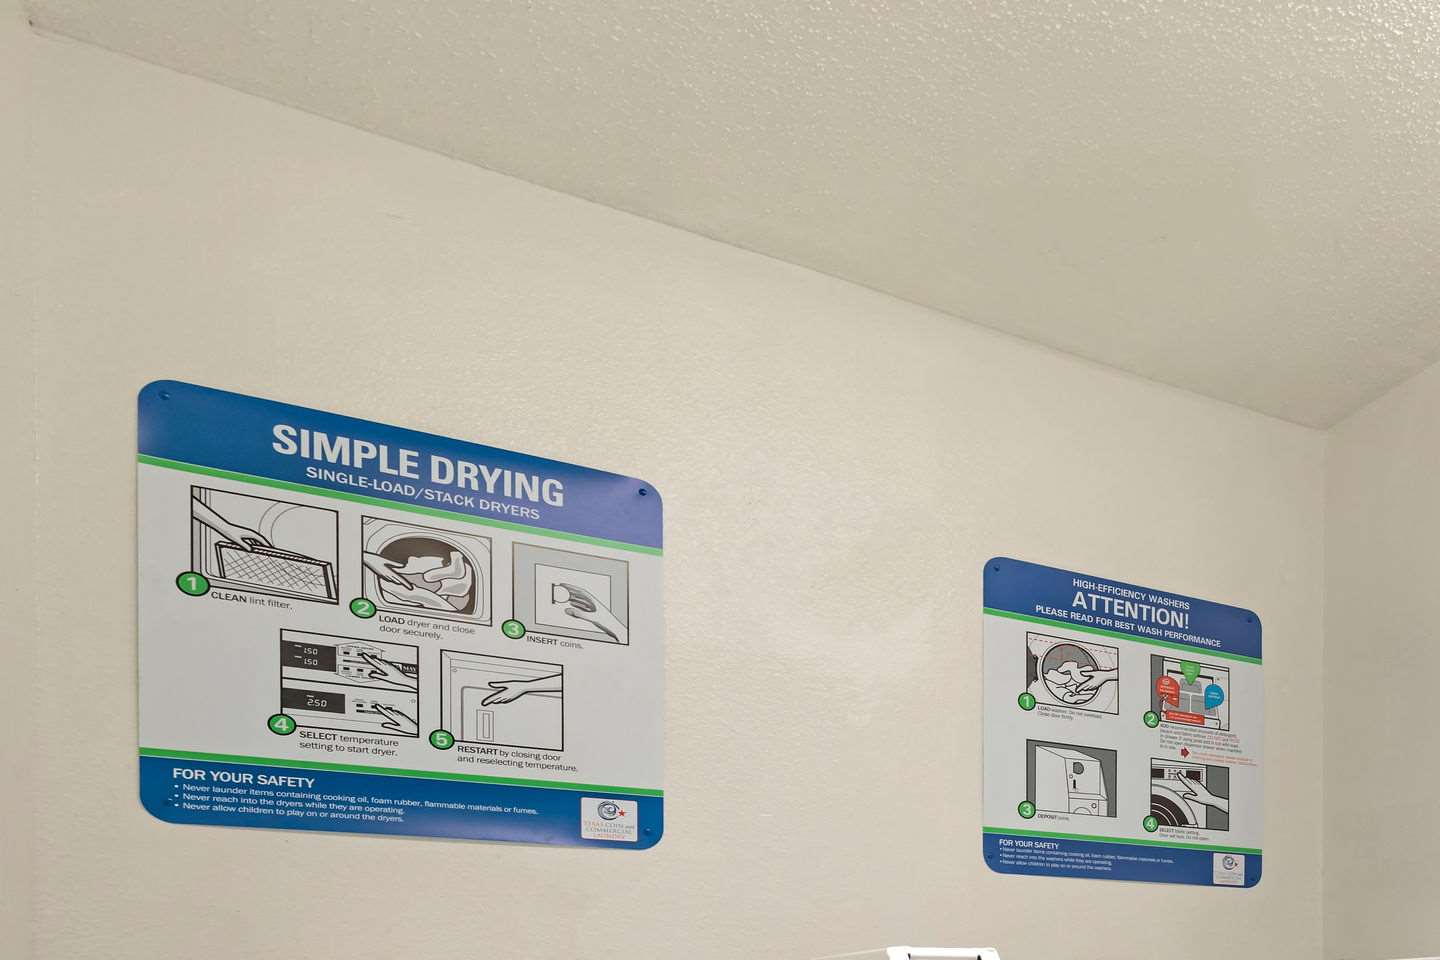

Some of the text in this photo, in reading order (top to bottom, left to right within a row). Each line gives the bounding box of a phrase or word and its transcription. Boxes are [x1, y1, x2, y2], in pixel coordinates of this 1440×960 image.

[272, 424, 565, 507] SIMPLE DRYING
[306, 466, 540, 520] SINGLE-LOAD/STACK DRYERS
[187, 576, 196, 591] 1
[211, 591, 293, 609] CLEAN lint filter.
[1073, 578, 1190, 610] HIGH-EFFICIENCY WASHERS
[357, 601, 369, 615] 2
[1072, 591, 1189, 630] ATTENTION!
[378, 615, 476, 634] LOAD dryer and close
[379, 625, 444, 640] door securely.
[509, 623, 520, 636] 3
[1035, 604, 1222, 648] PLEASE READ FOR BEST WASH PERFORMANCE
[526, 635, 558, 645] INSERT
[1023, 695, 1030, 708] 1
[273, 718, 289, 731] 4
[1148, 715, 1156, 725] 2
[299, 730, 399, 747] SELECT temperature
[435, 733, 448, 747] 5
[299, 741, 398, 757] setting to start dryer.
[457, 745, 561, 761] RESTART by closing door
[457, 756, 475, 764] and
[476, 757, 524, 769] reselecting
[172, 767, 315, 789] FOR YOUR SAFETY
[182, 783, 210, 792] Never
[212, 785, 248, 795] launder
[249, 787, 275, 797] items
[276, 790, 321, 801] containing
[323, 793, 356, 803] cooking
[182, 793, 210, 802] Never
[212, 795, 239, 804] reach
[260, 798, 275, 806] the
[276, 799, 303, 808] dryers
[305, 800, 327, 810] while
[329, 802, 347, 811] they
[1023, 804, 1032, 816] 3
[182, 802, 210, 811] Never
[212, 804, 237, 813] allow
[238, 806, 274, 815] children
[276, 808, 285, 816] to
[286, 808, 304, 818] play
[330, 811, 360, 820] around
[999, 838, 1060, 850] FOR YOUR SAFETY
